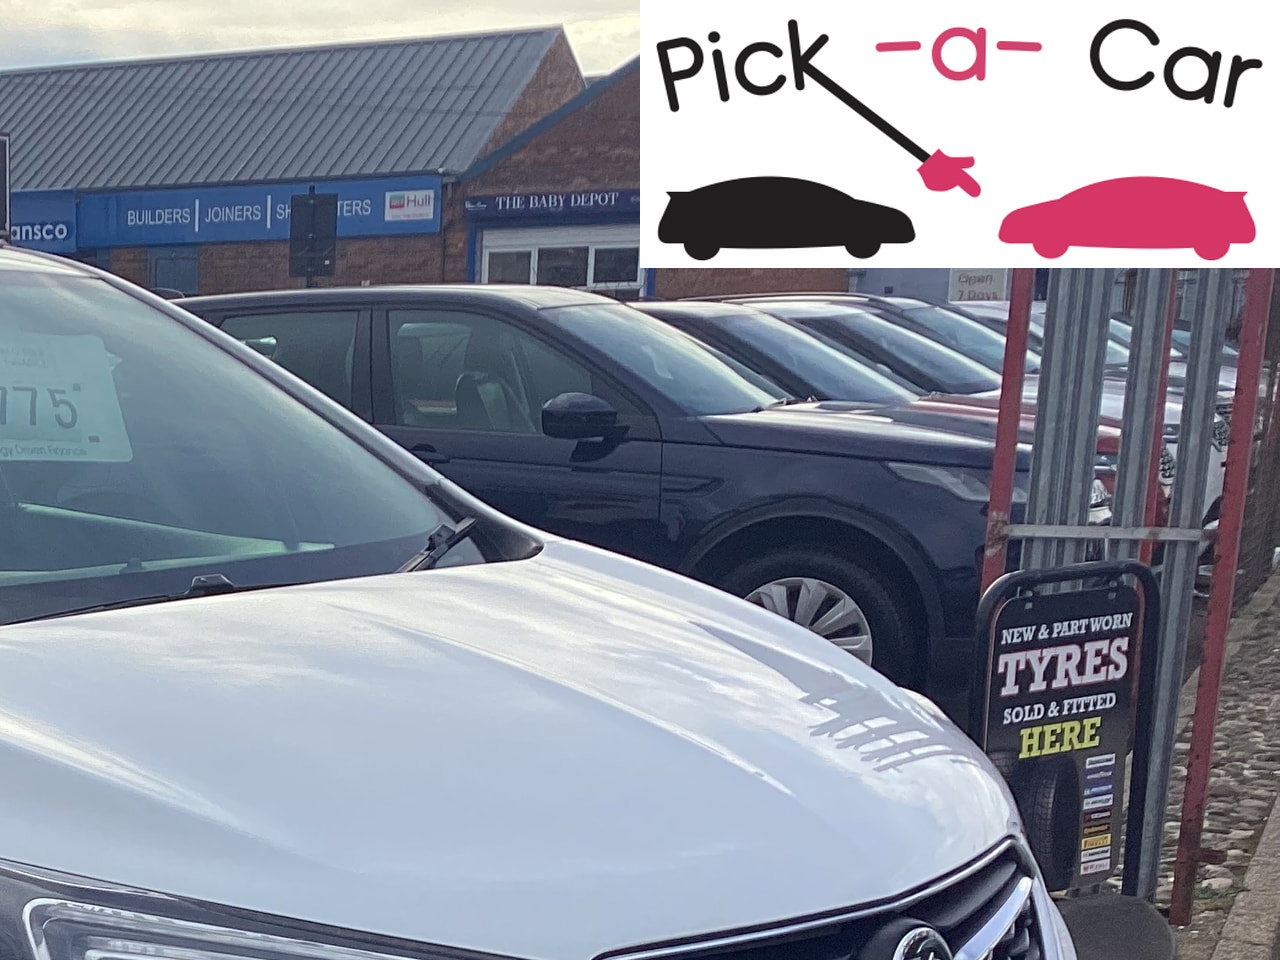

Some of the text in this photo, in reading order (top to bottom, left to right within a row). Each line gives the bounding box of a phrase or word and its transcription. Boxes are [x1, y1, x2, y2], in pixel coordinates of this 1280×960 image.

[406, 193, 431, 208] Hull
[496, 195, 525, 211] THE
[529, 194, 566, 209] BABY
[570, 192, 620, 208] DEPOT
[127, 208, 191, 226] BUILDERS
[204, 205, 262, 223] JOINERS
[958, 290, 965, 301] 7
[1000, 612, 1134, 645] NEW & PART WORN
[998, 636, 1130, 698] TYRES
[1003, 692, 1117, 725] SOLD & FITTED
[1018, 716, 1102, 760] HERE
